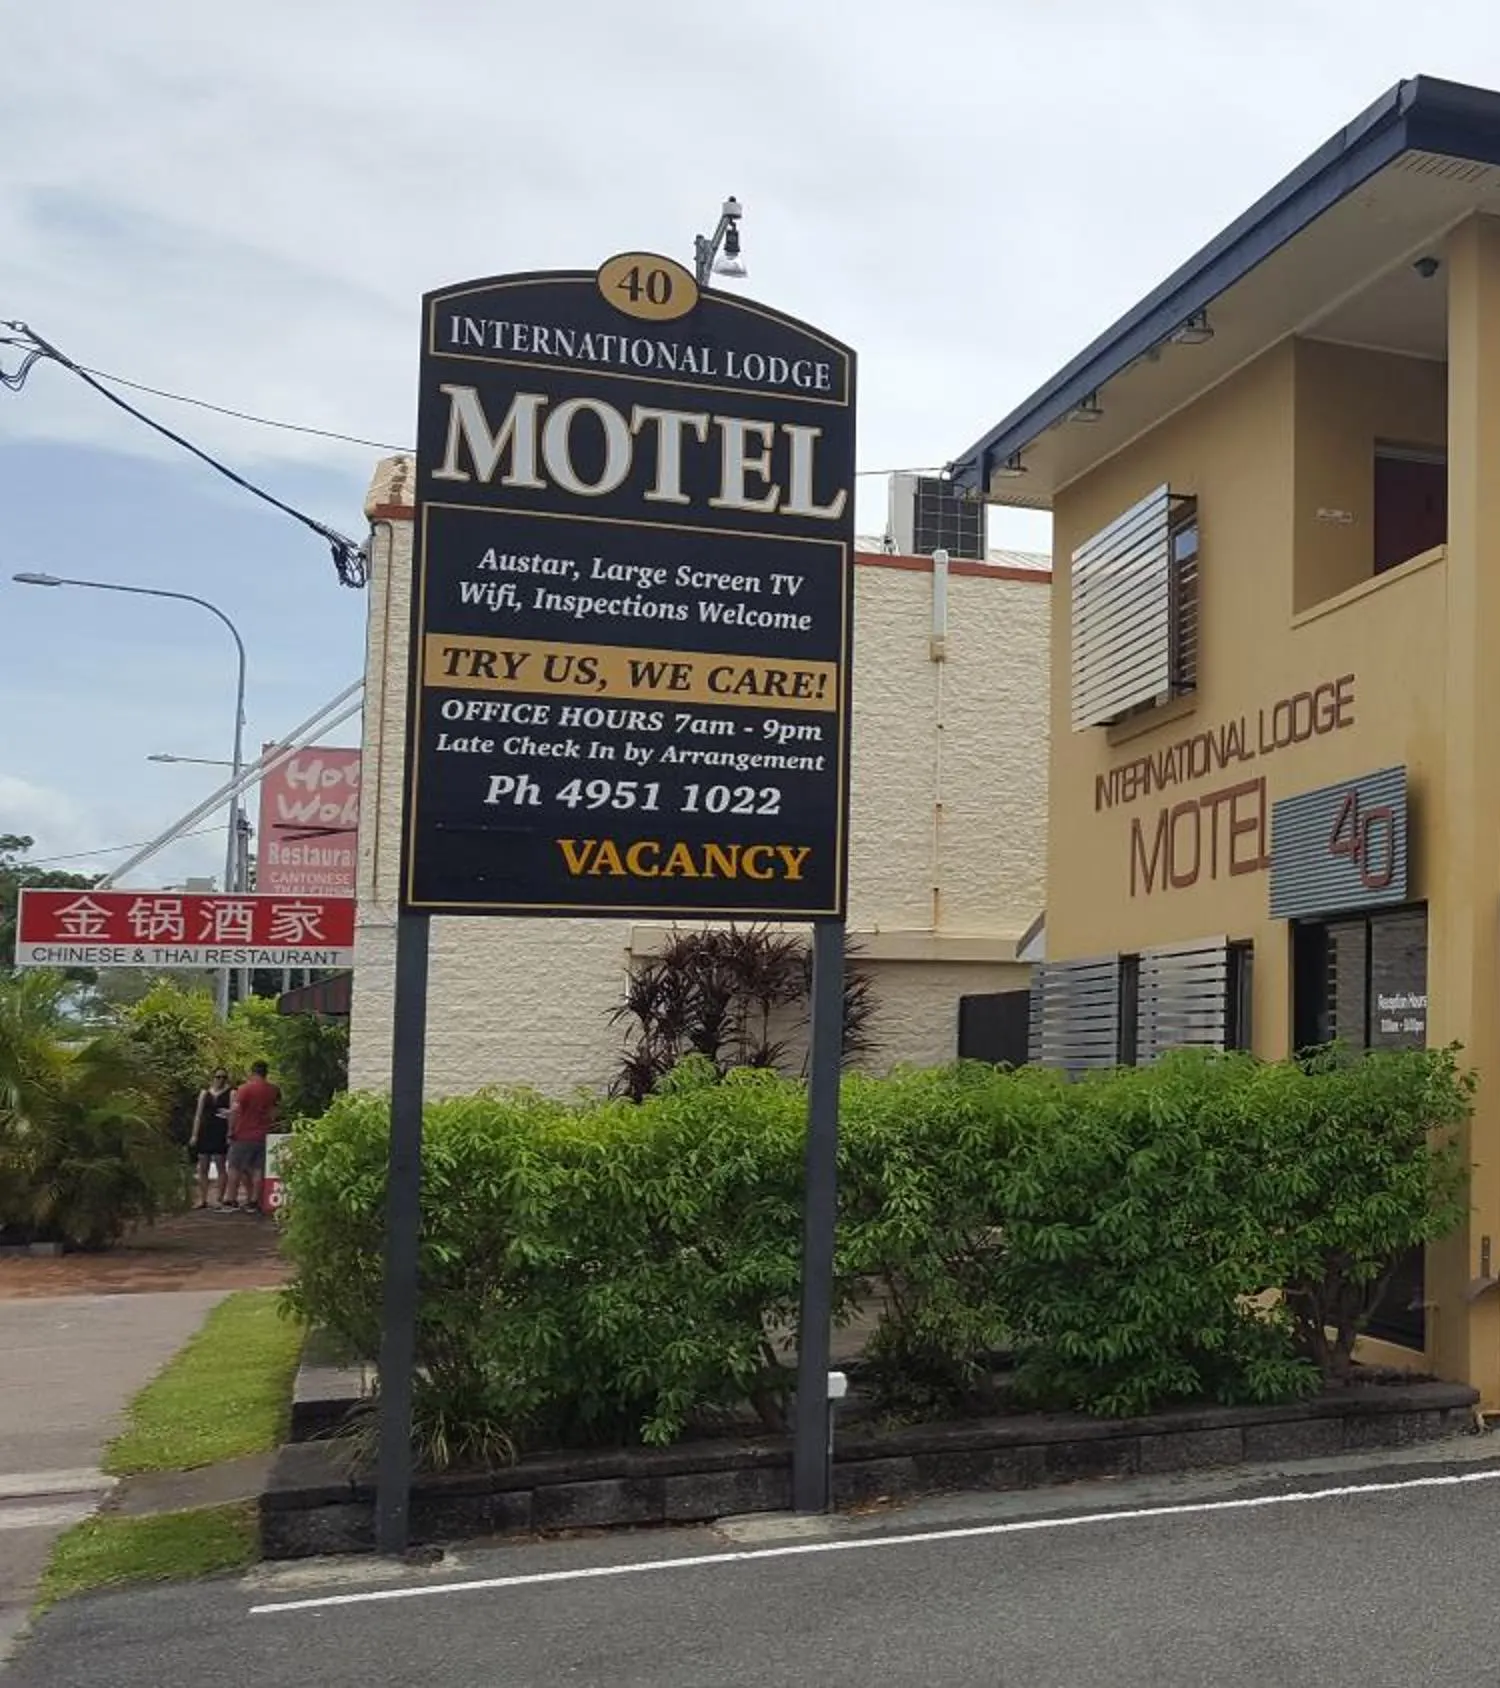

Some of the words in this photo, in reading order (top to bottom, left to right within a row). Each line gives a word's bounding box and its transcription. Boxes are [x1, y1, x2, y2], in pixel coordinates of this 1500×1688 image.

[617, 266, 673, 305] 40
[449, 315, 717, 376] INTERNATIONAL
[725, 351, 831, 390] LODGE
[431, 383, 848, 519] MOTEL
[477, 548, 580, 581] Austar,
[590, 557, 667, 588] Large
[675, 565, 761, 593] Screen
[770, 573, 804, 596] TV
[459, 581, 522, 611] Wifi,
[533, 587, 688, 620] Inspections
[698, 601, 811, 631] Welcome
[442, 647, 530, 679] TRY
[543, 656, 608, 692] US,
[627, 659, 693, 691] WE
[707, 665, 828, 699] CARE!
[441, 699, 550, 726] OFFICE
[559, 706, 663, 731] HOURS
[675, 713, 735, 736] 7am
[763, 719, 823, 745] 9pm
[1095, 716, 1255, 812] INTERNATIONAL
[1259, 674, 1355, 755] LODGE
[285, 760, 360, 792] Hot
[436, 734, 494, 753] Late
[503, 737, 580, 759] Check
[588, 741, 616, 761] In
[624, 743, 654, 767] by
[661, 747, 826, 772] Arrangement
[484, 775, 542, 806] Ph
[556, 779, 660, 811] 4951
[680, 784, 781, 816] 1022
[268, 842, 354, 867] Restaura
[557, 838, 811, 879] VACANCY
[1130, 776, 1270, 897] MOTEL
[1329, 789, 1393, 888] 40
[271, 871, 351, 885] CANTONESE
[52, 896, 325, 943] 金锅酒家
[32, 947, 125, 963] CHINESE
[133, 948, 146, 963] &
[152, 949, 198, 963] THAI
[205, 950, 339, 965] RESTAURANT
